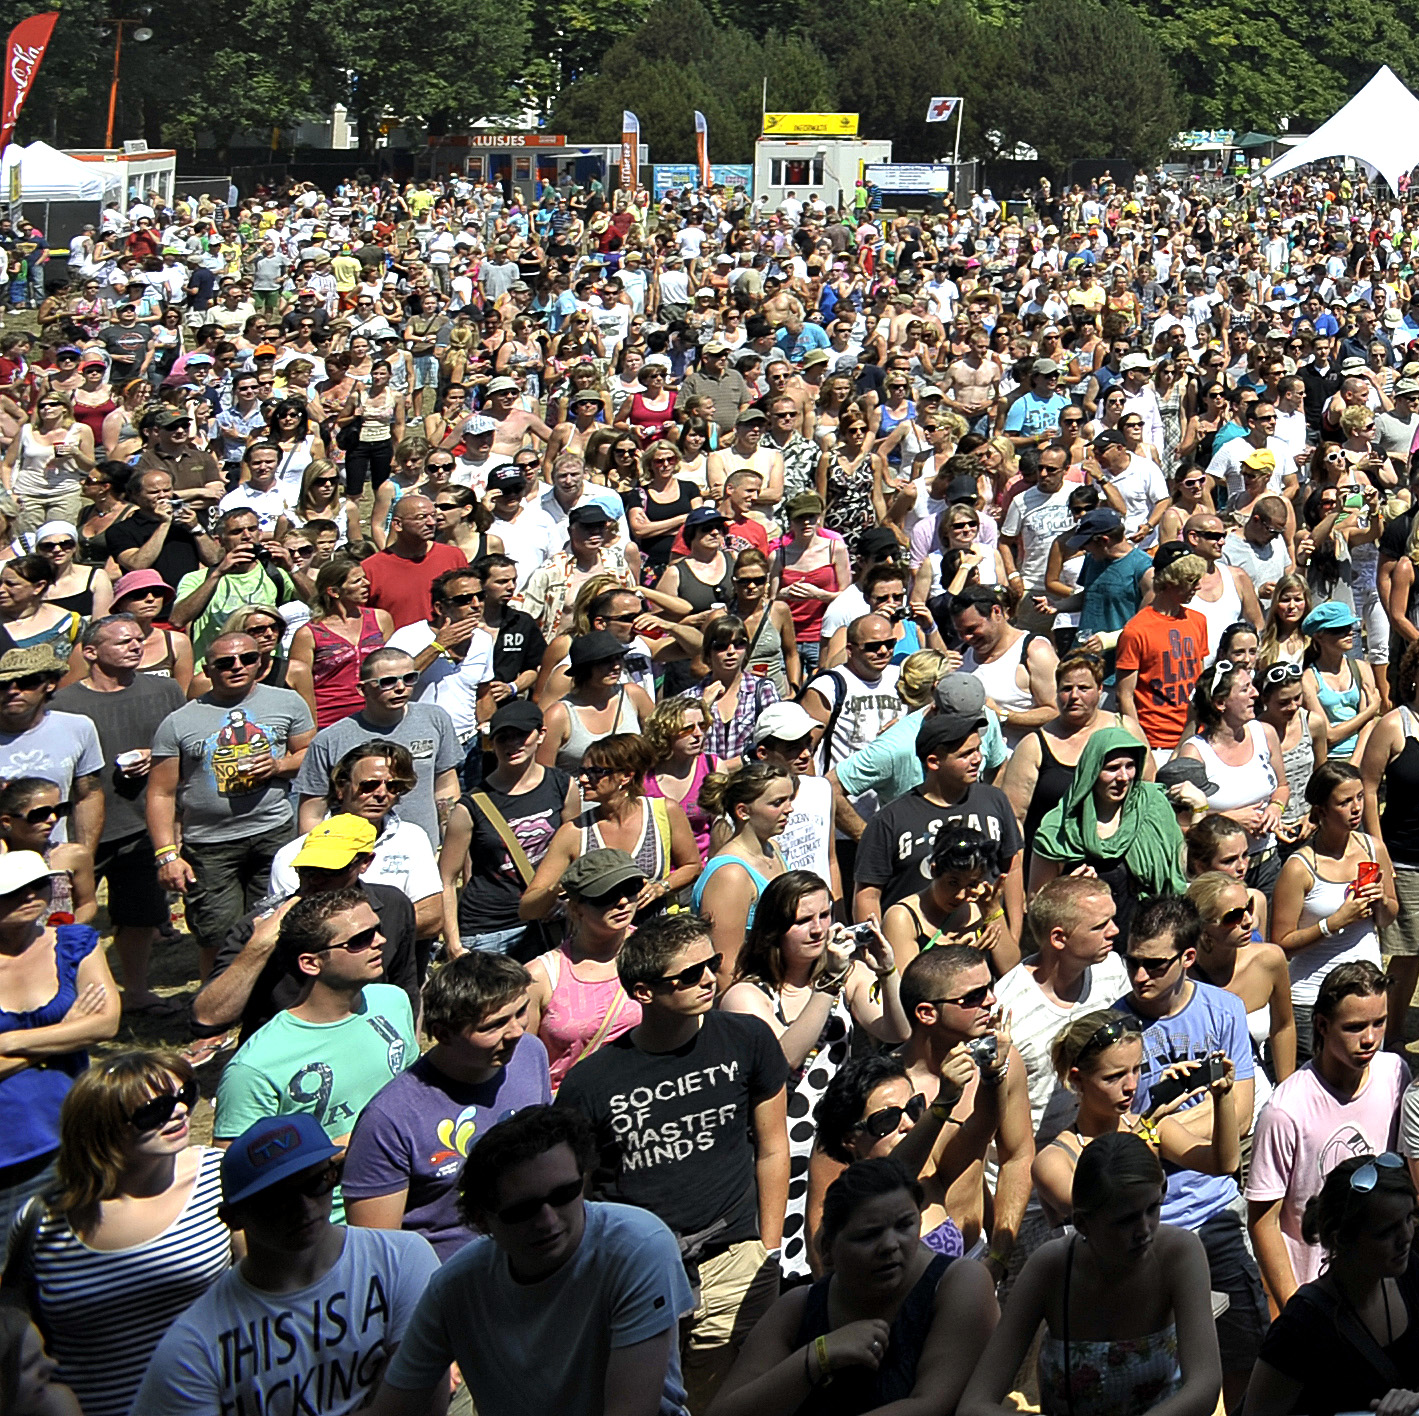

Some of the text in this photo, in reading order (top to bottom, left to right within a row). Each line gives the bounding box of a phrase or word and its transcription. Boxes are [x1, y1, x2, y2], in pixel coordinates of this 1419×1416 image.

[468, 135, 526, 146] KLUISJES
[503, 633, 524, 646] RD
[898, 813, 1001, 861] G-SAR
[609, 1060, 739, 1114] SOCIETY
[610, 1106, 652, 1135] OF
[254, 1133, 292, 1160] TV
[622, 1130, 716, 1173] MINDS
[218, 1274, 389, 1390] THIS IS A
